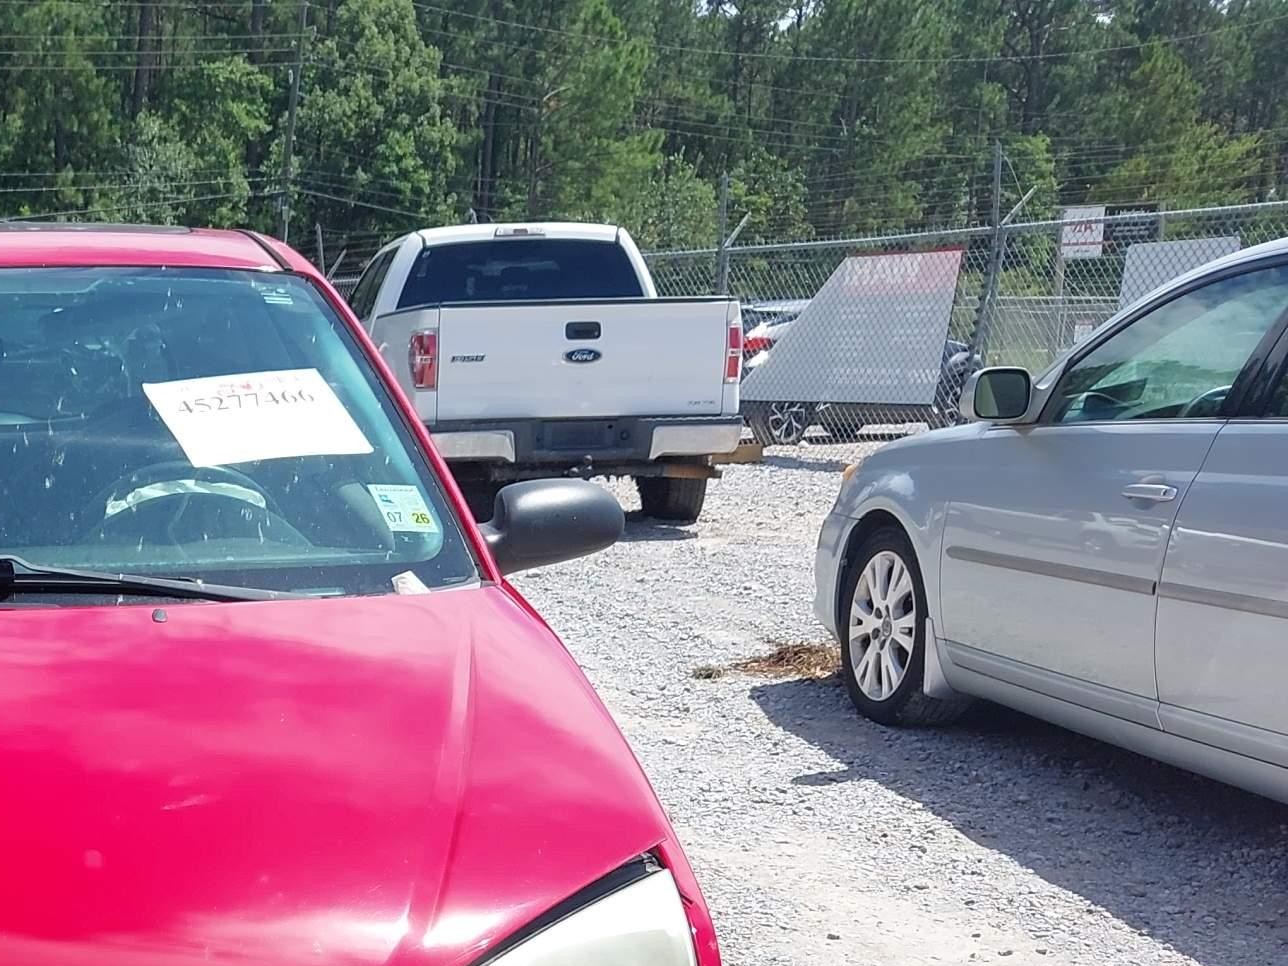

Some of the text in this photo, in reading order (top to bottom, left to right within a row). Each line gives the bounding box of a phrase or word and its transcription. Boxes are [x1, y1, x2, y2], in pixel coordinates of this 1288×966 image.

[177, 389, 316, 414] 45277466
[386, 511, 431, 524] 07 26
